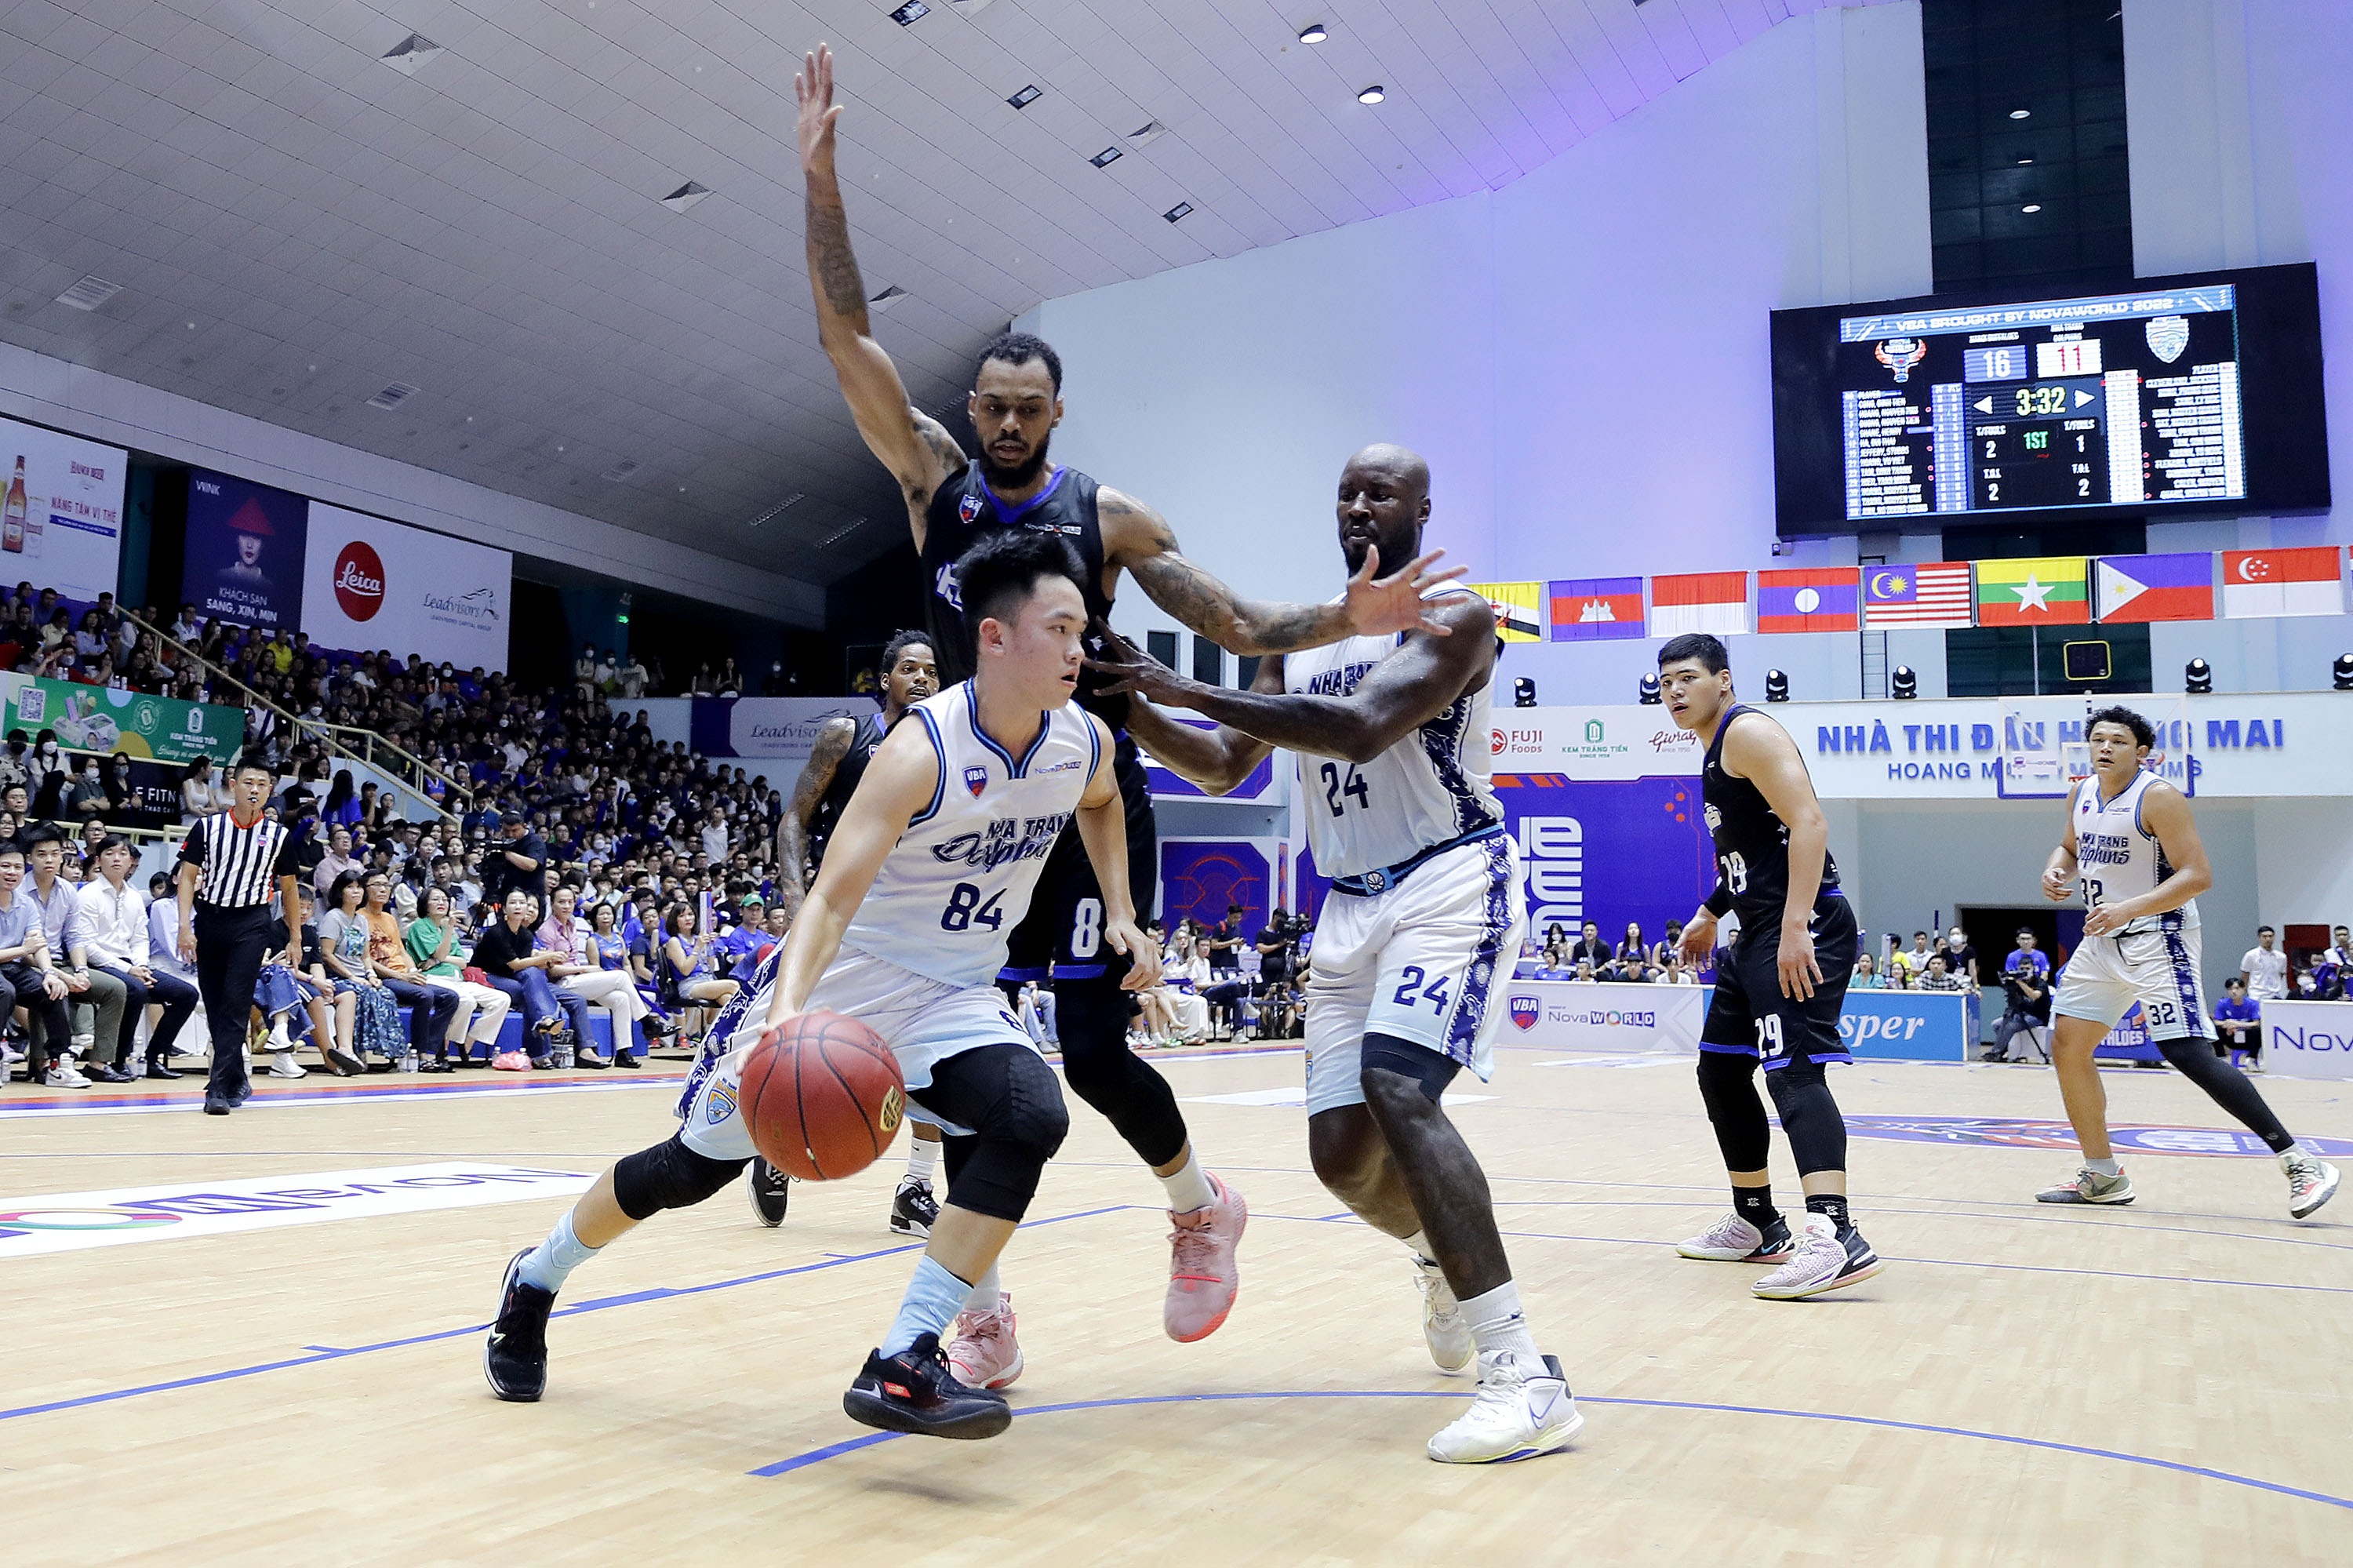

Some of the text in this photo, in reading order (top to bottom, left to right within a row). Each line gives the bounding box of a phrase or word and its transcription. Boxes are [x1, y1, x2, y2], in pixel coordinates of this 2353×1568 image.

[1930, 313, 2002, 328] BROUGHT
[2029, 301, 2129, 320] NOVAWORLD
[2133, 299, 2173, 311] 2022
[1983, 350, 2011, 378] 16
[2057, 344, 2081, 372] 11
[2015, 386, 2067, 417] 3:32
[1985, 440, 1997, 459] 2
[2023, 431, 2049, 449] 1ST
[2075, 434, 2086, 453] 1
[1988, 482, 1999, 501] 2
[2078, 478, 2090, 497] 2
[336, 561, 382, 597] Leica
[424, 593, 481, 618] Leadvisors
[1511, 730, 1543, 742] FUJI
[1817, 719, 1892, 753] NHÀ
[1903, 724, 1959, 752] THI
[2206, 719, 2284, 749] MAI
[966, 767, 986, 781] VBA
[1888, 762, 1971, 780] HOANG
[1320, 762, 1369, 817] 24
[940, 882, 1008, 933] 84
[1070, 897, 1102, 959] 8
[1393, 965, 1451, 1017] 24
[1512, 998, 1538, 1012] VBA
[2148, 1002, 2177, 1027] 32
[1838, 1013, 1926, 1048] sper
